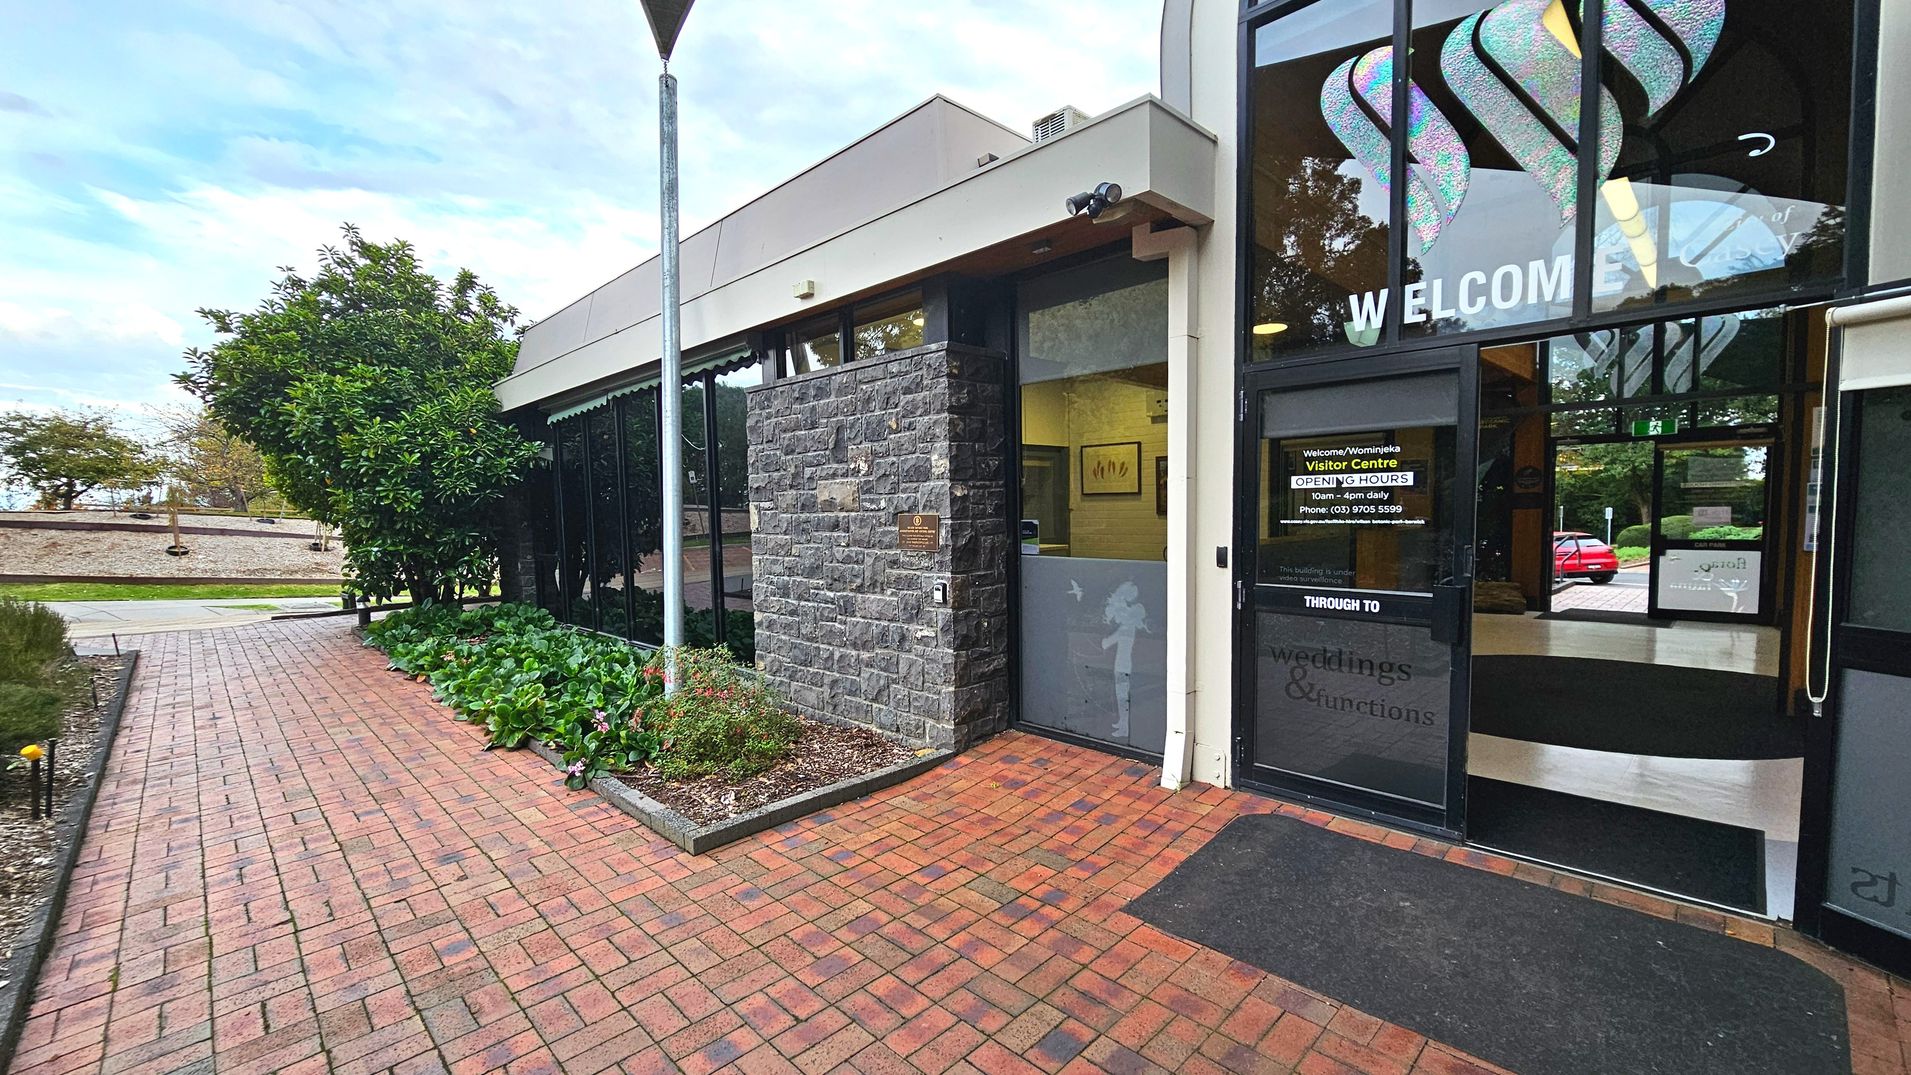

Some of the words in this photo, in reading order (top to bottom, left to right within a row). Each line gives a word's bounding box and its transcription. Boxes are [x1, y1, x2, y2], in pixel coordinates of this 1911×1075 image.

[1349, 247, 1623, 332] WELCOME
[1303, 445, 1401, 458] Welcome/Wominjeka
[1306, 460, 1348, 471] Visitor
[1351, 458, 1398, 470] Centre
[1295, 475, 1355, 487] OPENING
[1359, 473, 1409, 485] HOURS
[1311, 492, 1334, 500] 10am
[1343, 491, 1365, 501] 4pm
[1366, 491, 1390, 500] daily
[1299, 506, 1329, 514] Phone:
[1330, 505, 1350, 515] (03)
[1352, 505, 1376, 514] 9705
[1378, 505, 1403, 514] 5599
[1294, 567, 1324, 576] building
[1299, 576, 1343, 584] surveillance
[1304, 595, 1360, 611] THROUGH
[1362, 599, 1380, 613] TO
[1269, 643, 1412, 686] weddings
[1285, 665, 1318, 701] &
[1316, 689, 1436, 727] functions
